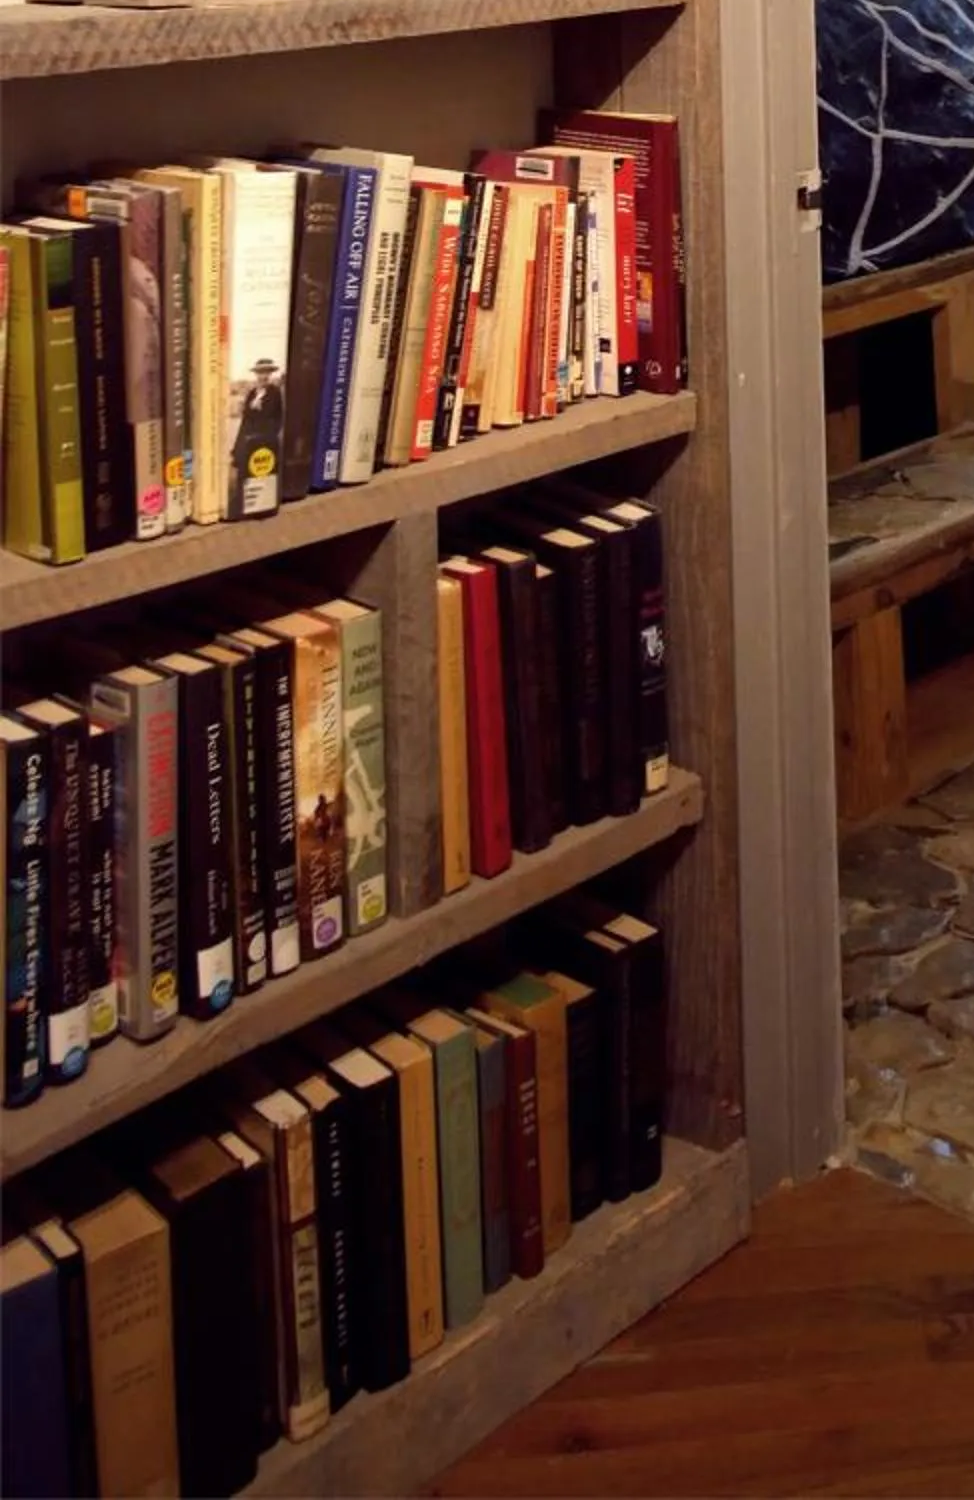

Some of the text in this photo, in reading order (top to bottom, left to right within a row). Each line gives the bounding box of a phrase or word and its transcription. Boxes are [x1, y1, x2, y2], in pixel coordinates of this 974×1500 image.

[344, 174, 372, 300] FALLING OFF AIR
[335, 317, 353, 383] CATHERINE
[425, 235, 457, 395] WIDE SARGASSO SEA
[352, 643, 378, 659] NOW
[22, 753, 44, 846] Celeste Ng
[205, 721, 225, 846] Dead Letters
[22, 860, 44, 1051] Little Fires Everywhere
[147, 841, 176, 974] MARK ALPER
